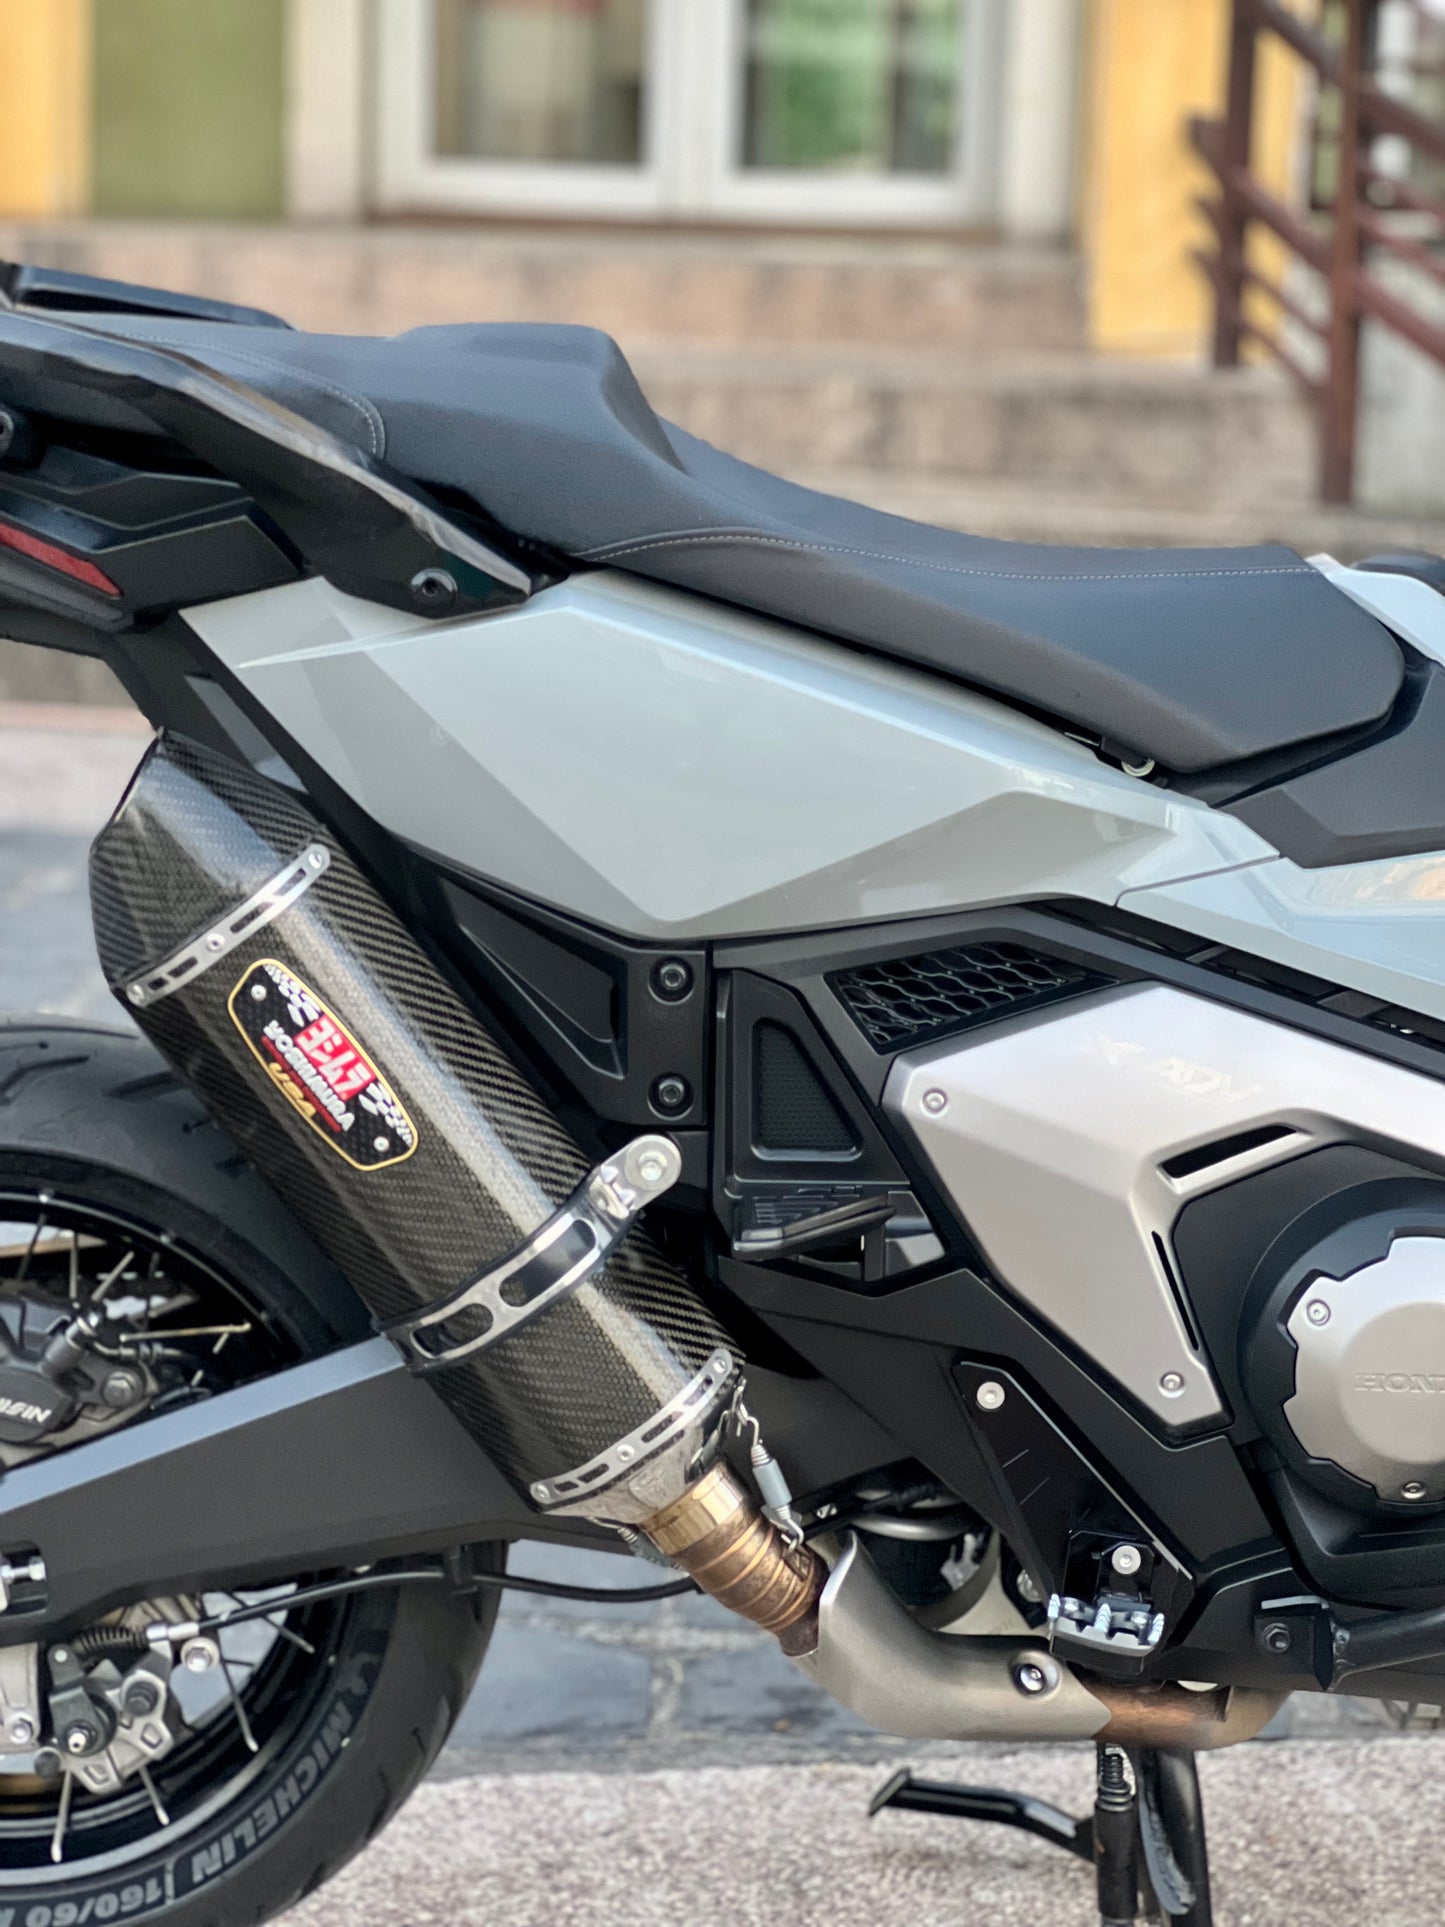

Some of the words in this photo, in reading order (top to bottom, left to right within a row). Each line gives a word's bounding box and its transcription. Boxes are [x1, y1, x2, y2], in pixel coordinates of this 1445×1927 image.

[263, 1020, 355, 1131] YOSHIMURA
[296, 1017, 373, 1094] ヨシムラ
[1355, 1372, 1445, 1394] HON
[191, 1700, 352, 1884] MICHELIN
[26, 1876, 163, 1927] 160/60
